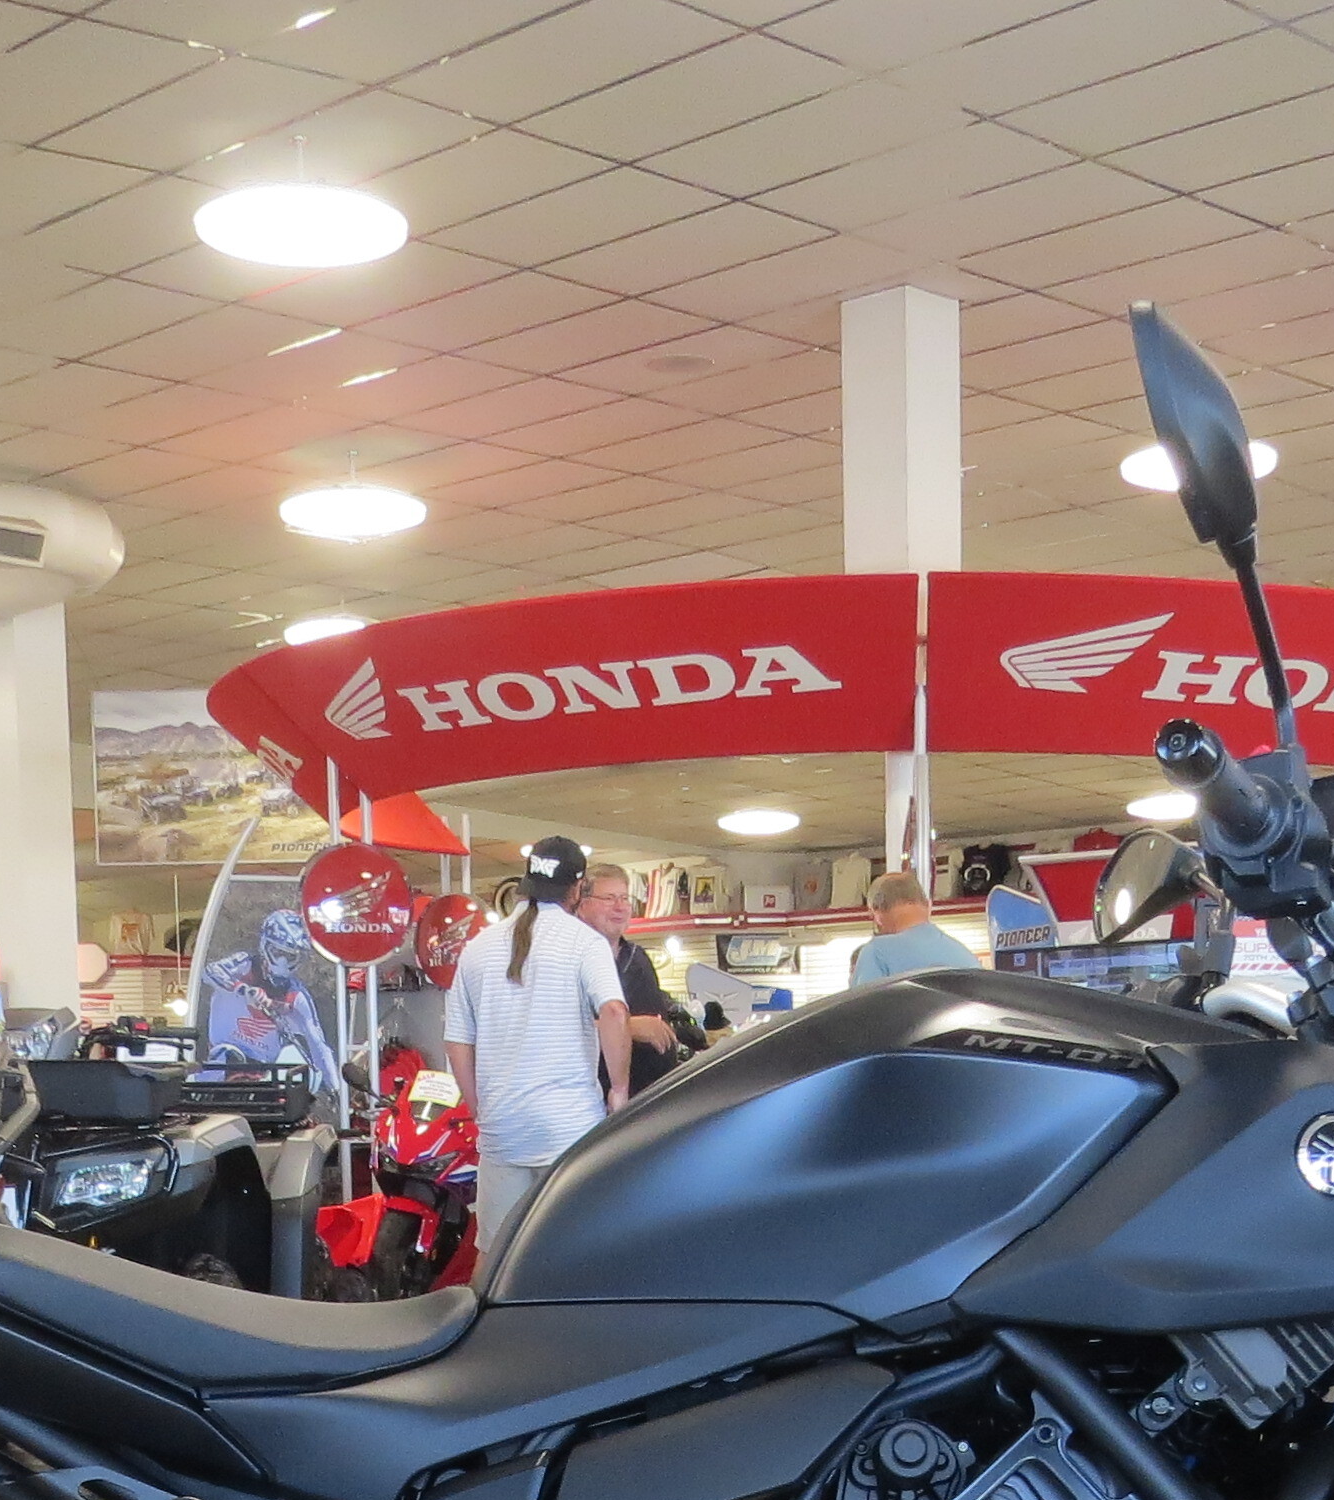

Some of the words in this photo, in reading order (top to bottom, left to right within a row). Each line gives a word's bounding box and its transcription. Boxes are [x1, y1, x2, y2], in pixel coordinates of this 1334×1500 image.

[397, 645, 842, 732] HONDA
[325, 922, 394, 934] HONDA
[996, 926, 1051, 948] PIONEER
